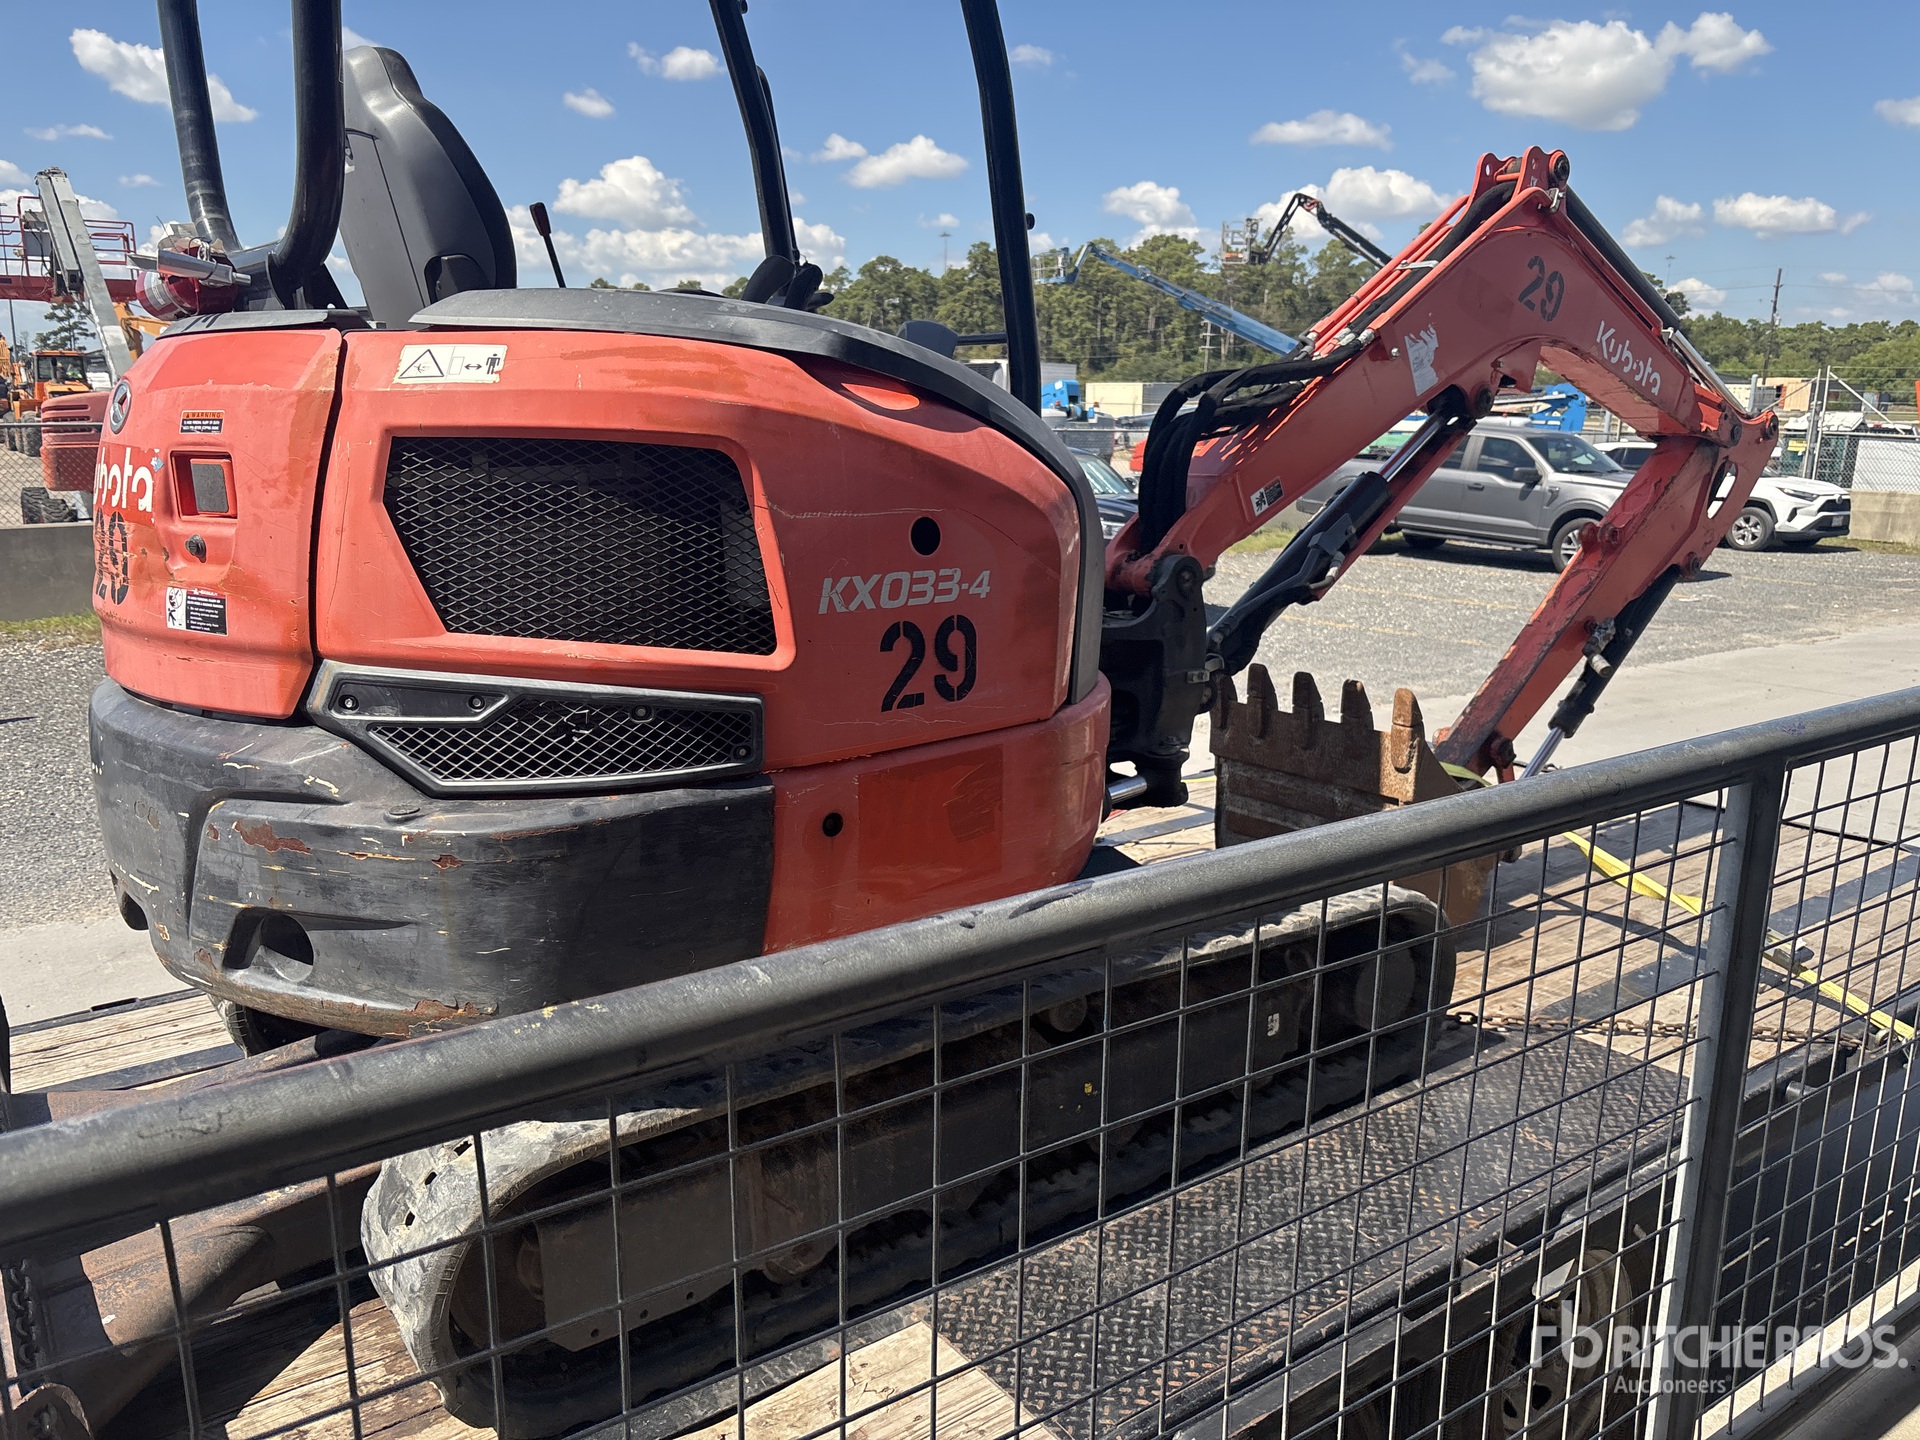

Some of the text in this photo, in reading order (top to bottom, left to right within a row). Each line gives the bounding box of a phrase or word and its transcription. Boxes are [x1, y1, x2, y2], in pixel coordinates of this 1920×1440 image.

[1518, 255, 1565, 322] 29
[1596, 320, 1661, 396] Kubota
[818, 567, 991, 615] KX033-4
[880, 614, 977, 712] 29
